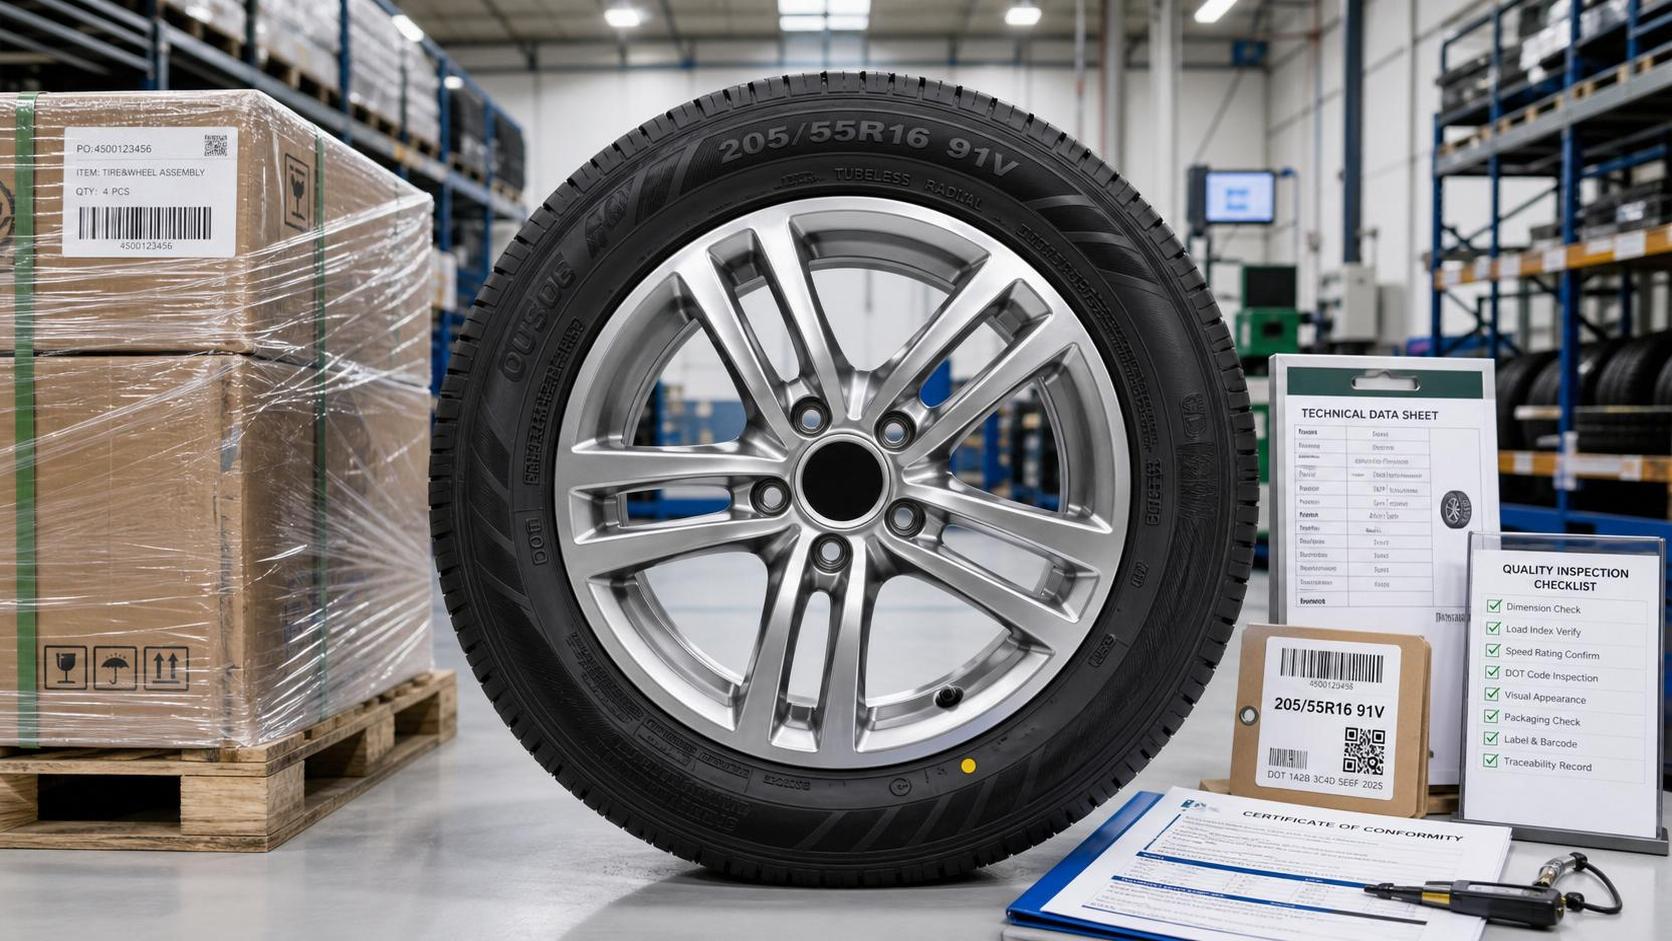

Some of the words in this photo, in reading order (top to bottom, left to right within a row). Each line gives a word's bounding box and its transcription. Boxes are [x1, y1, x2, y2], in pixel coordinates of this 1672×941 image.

[718, 119, 930, 164] 205/55R16
[946, 137, 1020, 177] 91V
[76, 168, 100, 177] ITEM:
[103, 168, 157, 177] TIRE&WHEEL
[159, 168, 205, 177] ASSEMBLY
[834, 167, 912, 187] TUBELESS
[75, 187, 98, 197] QTY:
[102, 187, 109, 196] 4
[111, 187, 130, 196] PCS
[1301, 408, 1367, 420] TECHNICAL
[1369, 409, 1399, 420] DATA
[1402, 410, 1439, 421] SHEET
[1502, 564, 1553, 576] QUALITY
[1557, 566, 1629, 579] INSPECTION
[1534, 580, 1597, 592] CHECKLIST
[1506, 602, 1551, 613] Dimension
[1553, 604, 1581, 614] Check
[1506, 624, 1528, 634] Load
[1530, 626, 1554, 636] Index
[1556, 627, 1582, 638] Verify
[1505, 647, 1533, 659] Speed
[1535, 648, 1563, 660] Rating
[1564, 650, 1600, 660] Confirm
[1505, 669, 1525, 678] DOT
[1527, 669, 1551, 680] Code
[1553, 672, 1599, 683] Inspection
[1504, 691, 1532, 701] Visual
[1533, 693, 1587, 705] Appearance
[1274, 697, 1352, 716] 205/55R16
[1357, 704, 1385, 719] 91V
[1504, 713, 1551, 726] Packaging
[1552, 716, 1581, 727] Check
[1504, 735, 1529, 745] Label
[1531, 736, 1539, 746] &
[1540, 738, 1578, 749] Barcode
[1504, 757, 1557, 771] Traceability
[1559, 760, 1592, 772] Record
[1267, 770, 1286, 779] DOT
[1242, 810, 1336, 829] CERTIFICATE
[1338, 823, 1360, 831] OF
[1363, 826, 1464, 842] CONFORMITY
